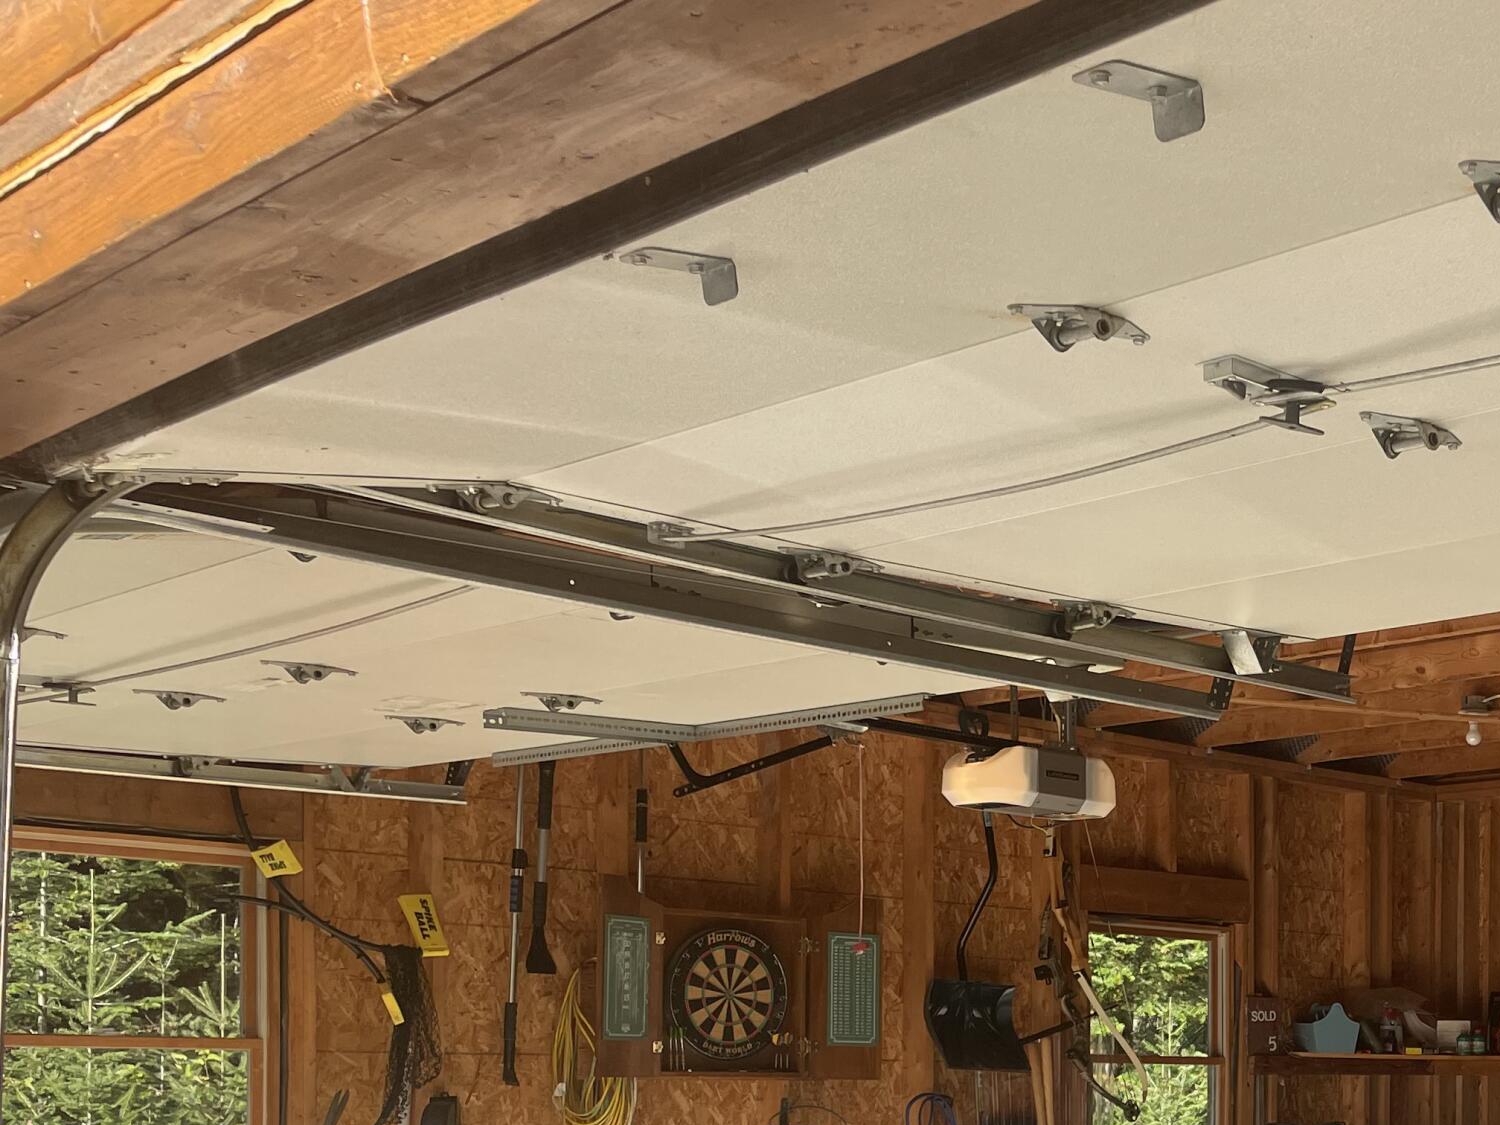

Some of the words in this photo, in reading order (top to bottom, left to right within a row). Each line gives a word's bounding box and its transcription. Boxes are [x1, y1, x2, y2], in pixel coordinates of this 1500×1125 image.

[419, 898, 438, 932] SPIKE
[414, 911, 431, 940] BALL
[707, 930, 757, 948] Harrows
[1251, 1010, 1277, 1022] SOLD
[1268, 1036, 1277, 1052] 5
